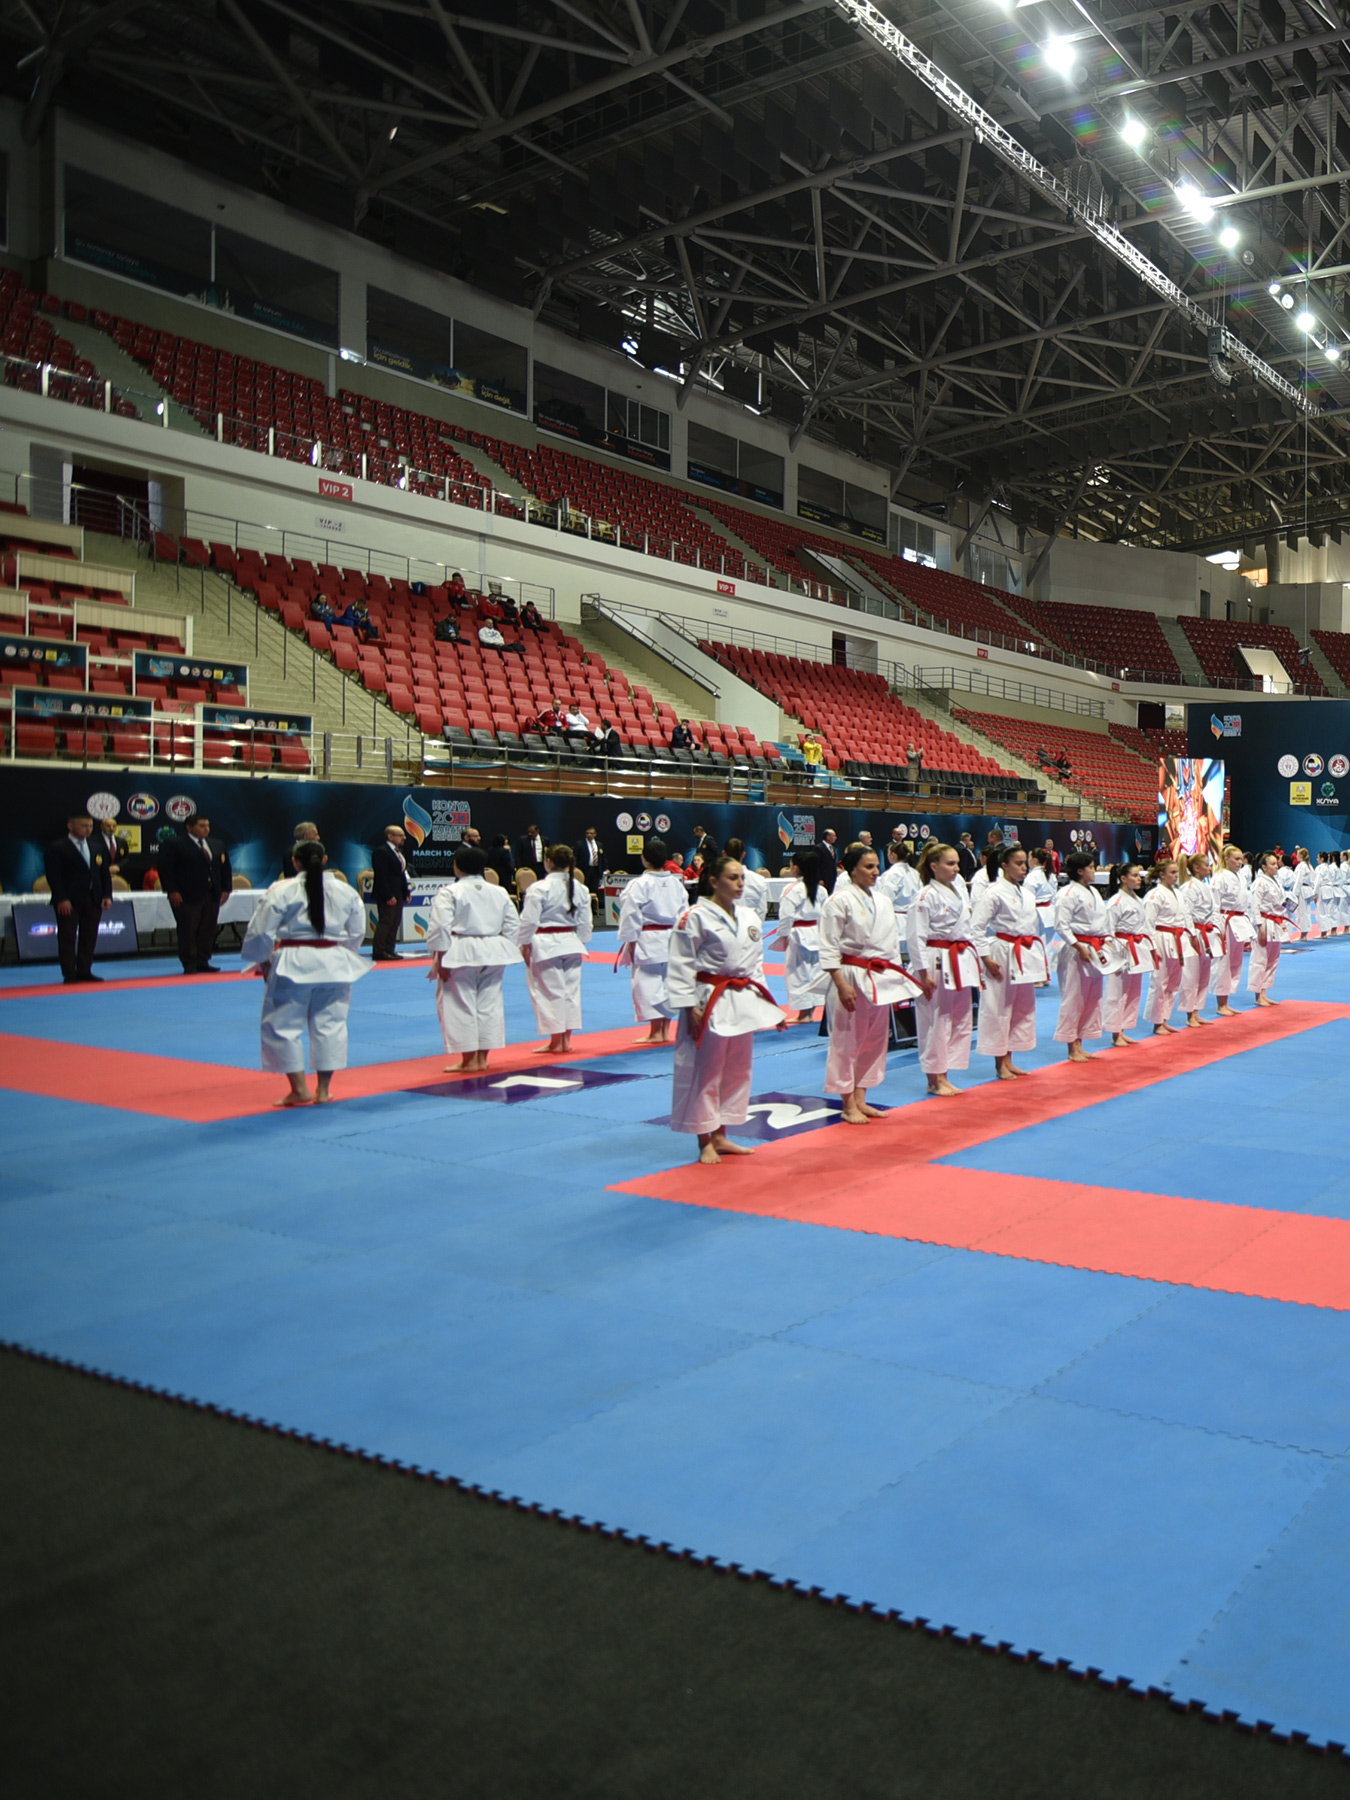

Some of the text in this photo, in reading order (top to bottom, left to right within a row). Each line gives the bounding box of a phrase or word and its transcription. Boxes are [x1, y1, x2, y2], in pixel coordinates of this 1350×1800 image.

[322, 482, 349, 497] VIP 2
[719, 582, 729, 591] VIP
[432, 799, 471, 811] KONYA
[432, 811, 471, 825] 2023
[746, 1103, 843, 1129] 2
